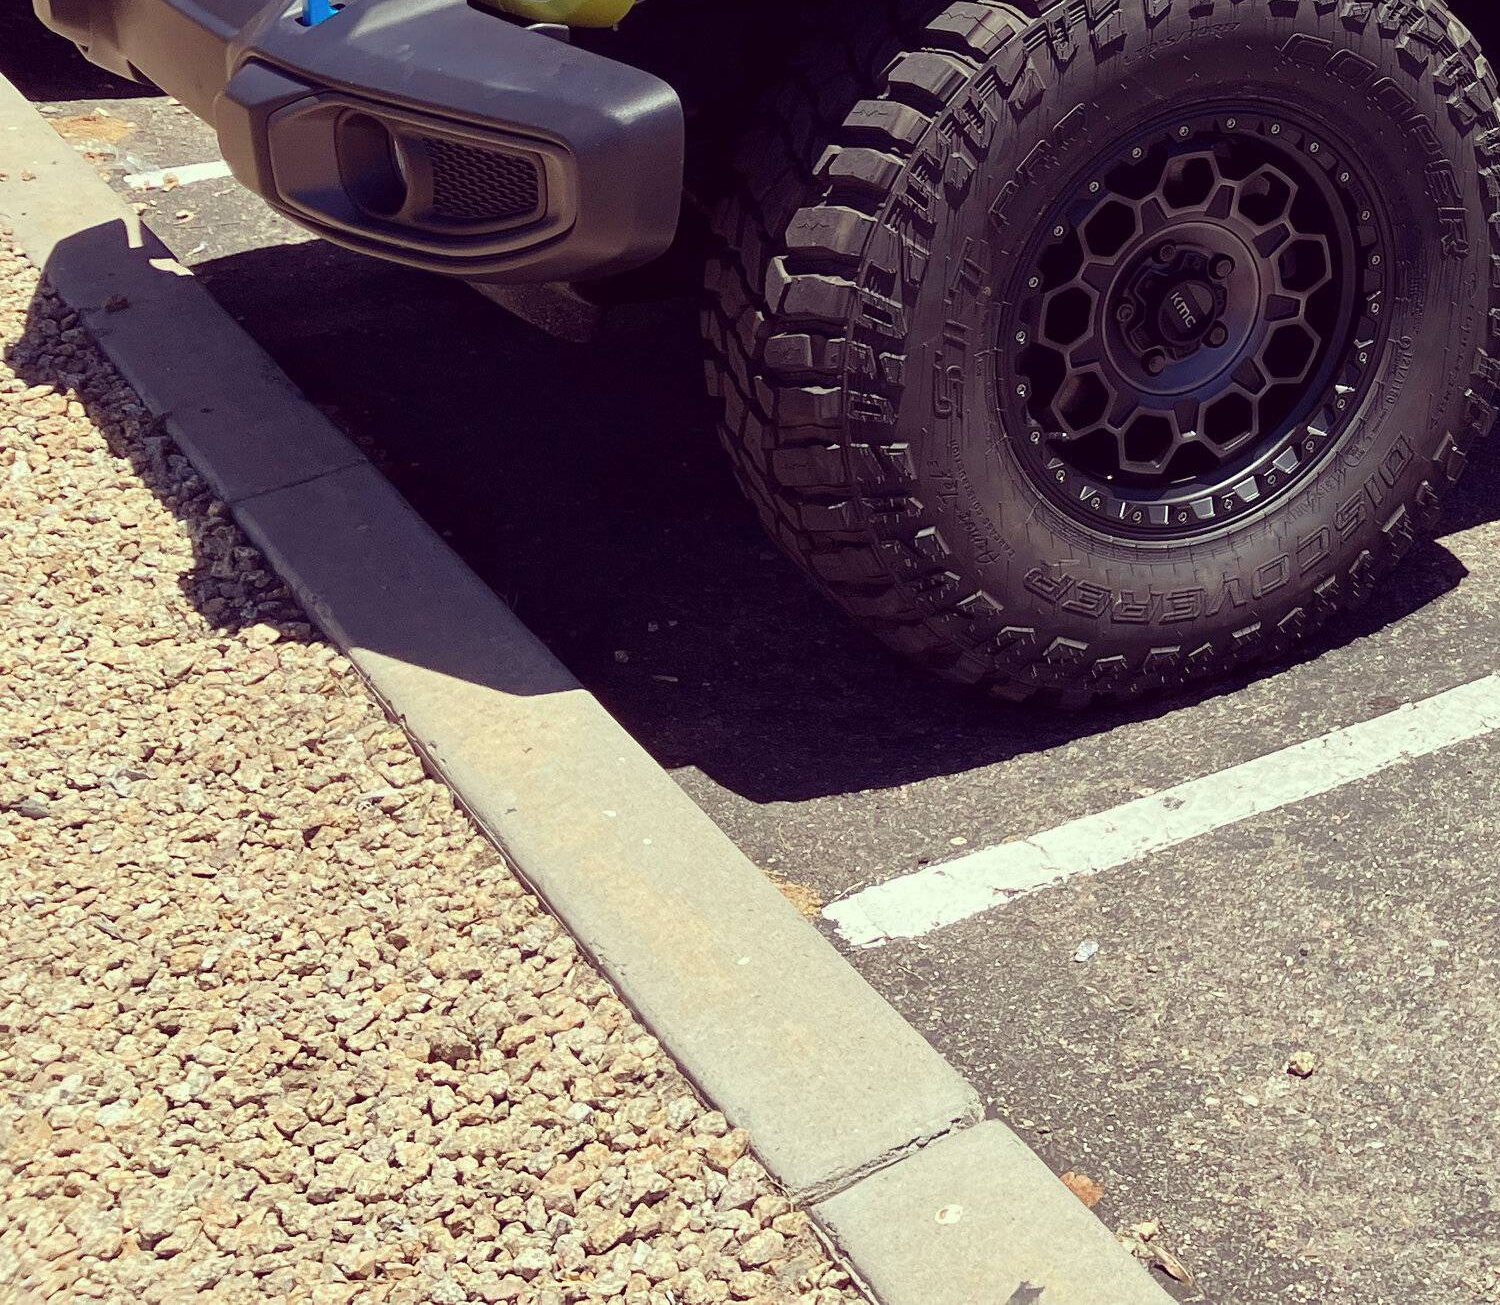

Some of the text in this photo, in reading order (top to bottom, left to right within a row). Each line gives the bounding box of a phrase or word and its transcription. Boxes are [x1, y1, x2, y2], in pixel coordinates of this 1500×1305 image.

[1279, 32, 1470, 262] COOPER
[1169, 291, 1197, 329] KMC
[1022, 433, 1416, 625] DISCOVERER
